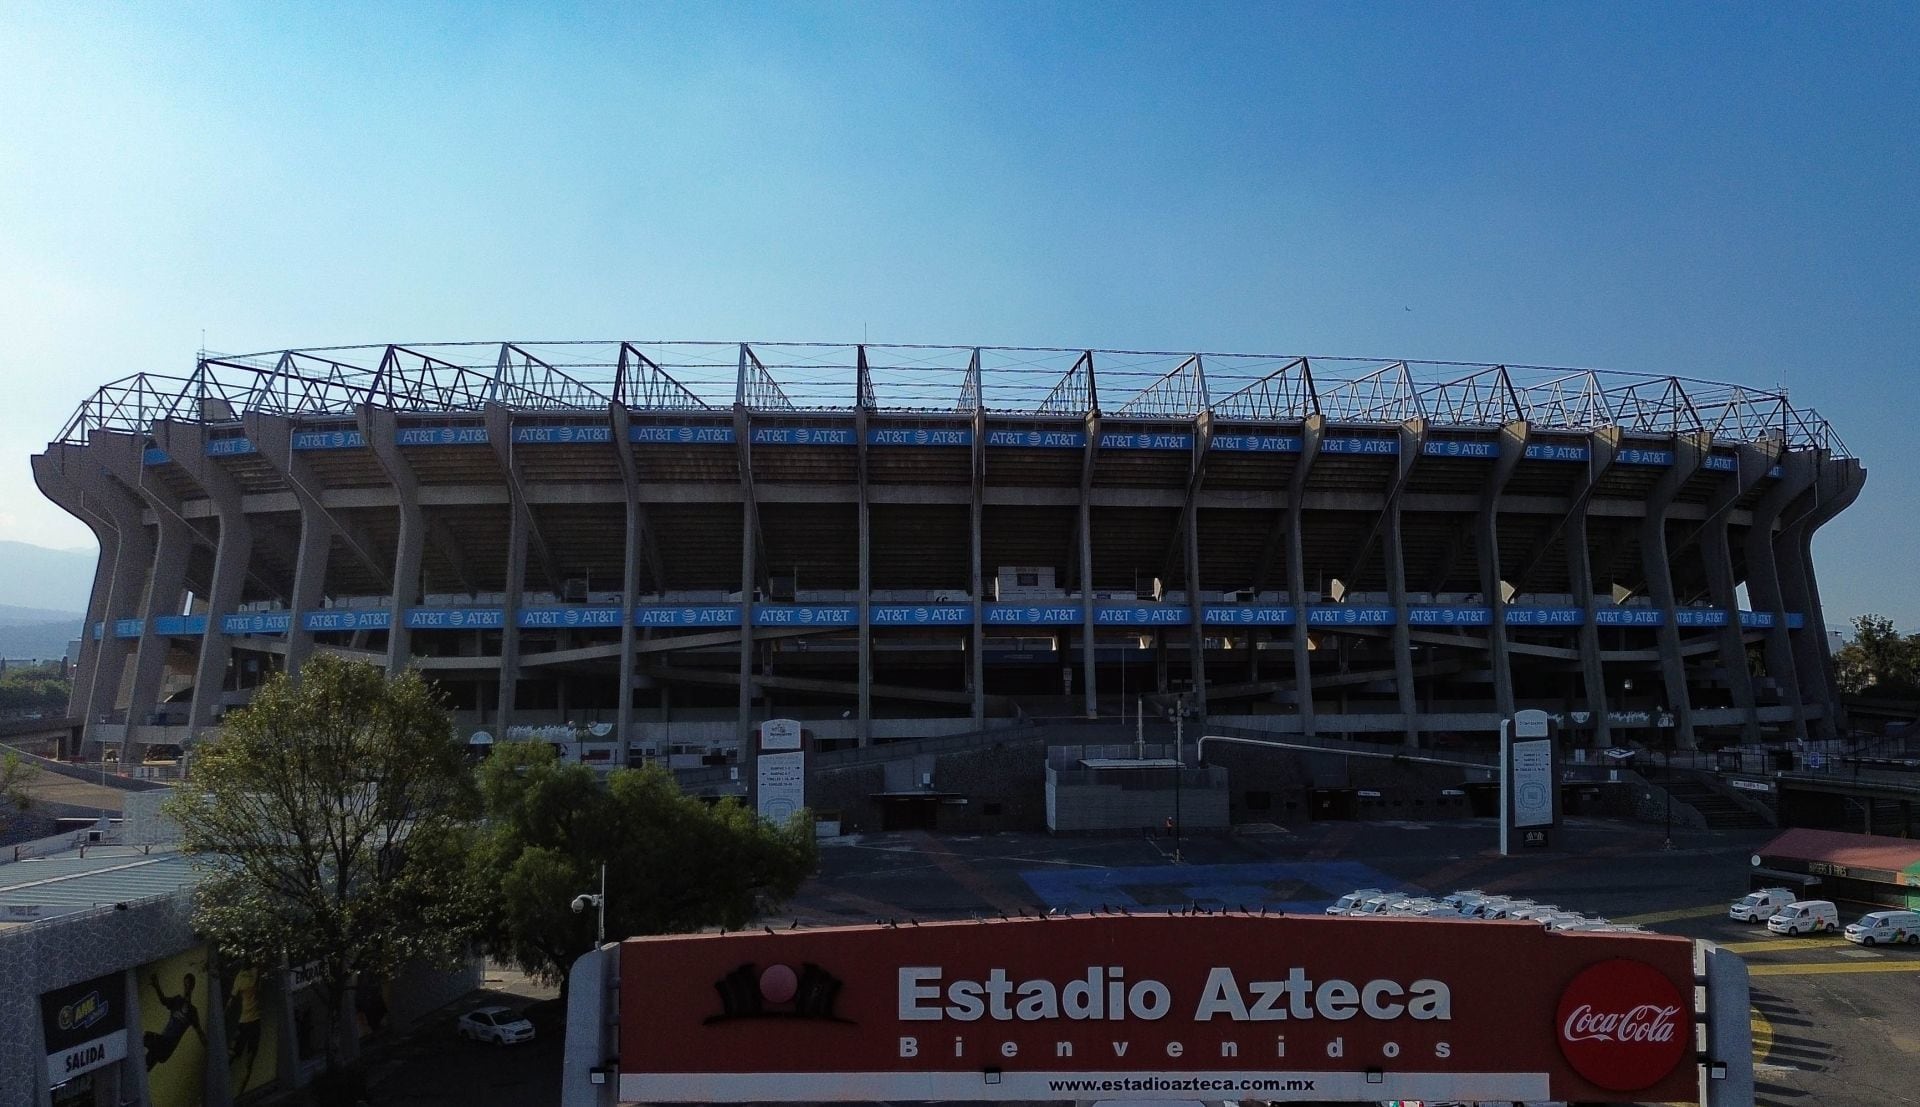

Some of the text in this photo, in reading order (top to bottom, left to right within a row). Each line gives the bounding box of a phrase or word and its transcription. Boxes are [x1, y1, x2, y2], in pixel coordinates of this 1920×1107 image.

[299, 434, 327, 446] AT&T
[403, 431, 435, 442] AT&T
[518, 428, 609, 441] AT&T AT&T
[638, 428, 732, 440] AT&T AT&T
[756, 429, 847, 442] AT&T AT&T
[875, 431, 965, 443] AT&T AT&T
[990, 432, 1077, 445] AT&T AT&T
[212, 442, 236, 452] AT&T
[1101, 435, 1186, 448] AT&T AT&T
[1211, 437, 1293, 449] AT&T AT&T
[1364, 441, 1395, 452] AT&T
[1462, 444, 1490, 455] AT&T
[1557, 447, 1584, 458] AT&T
[1640, 452, 1667, 463] AT&T
[1713, 458, 1732, 469] AT&T
[309, 613, 390, 627] AT&T AT&T
[411, 612, 501, 624] AT&T AT&T
[524, 611, 617, 623] AT&T AT&T
[642, 610, 735, 622] AT&T AT&T
[759, 609, 851, 622] AT&T AT&T
[876, 609, 965, 621] AT&T AT&T
[990, 609, 1077, 621] AT&T AT&T
[1099, 610, 1184, 621] AT&T AT&T
[1205, 610, 1288, 621] AT&T AT&T
[1310, 610, 1389, 622] AT&T AT&T
[1410, 610, 1486, 622] AT&T AT&T
[1506, 611, 1576, 622] AT&T AT&T
[1595, 612, 1658, 622] AT&T AT&T
[1703, 612, 1723, 623] AT&T
[225, 617, 289, 629] AT&T AT&T
[899, 967, 1452, 1021] Estadio Azteca
[1564, 1004, 1680, 1042] Coca-Cola
[66, 1044, 105, 1073] SALIDA
[1049, 1077, 1315, 1091] www.estadioazteca.com.mx
